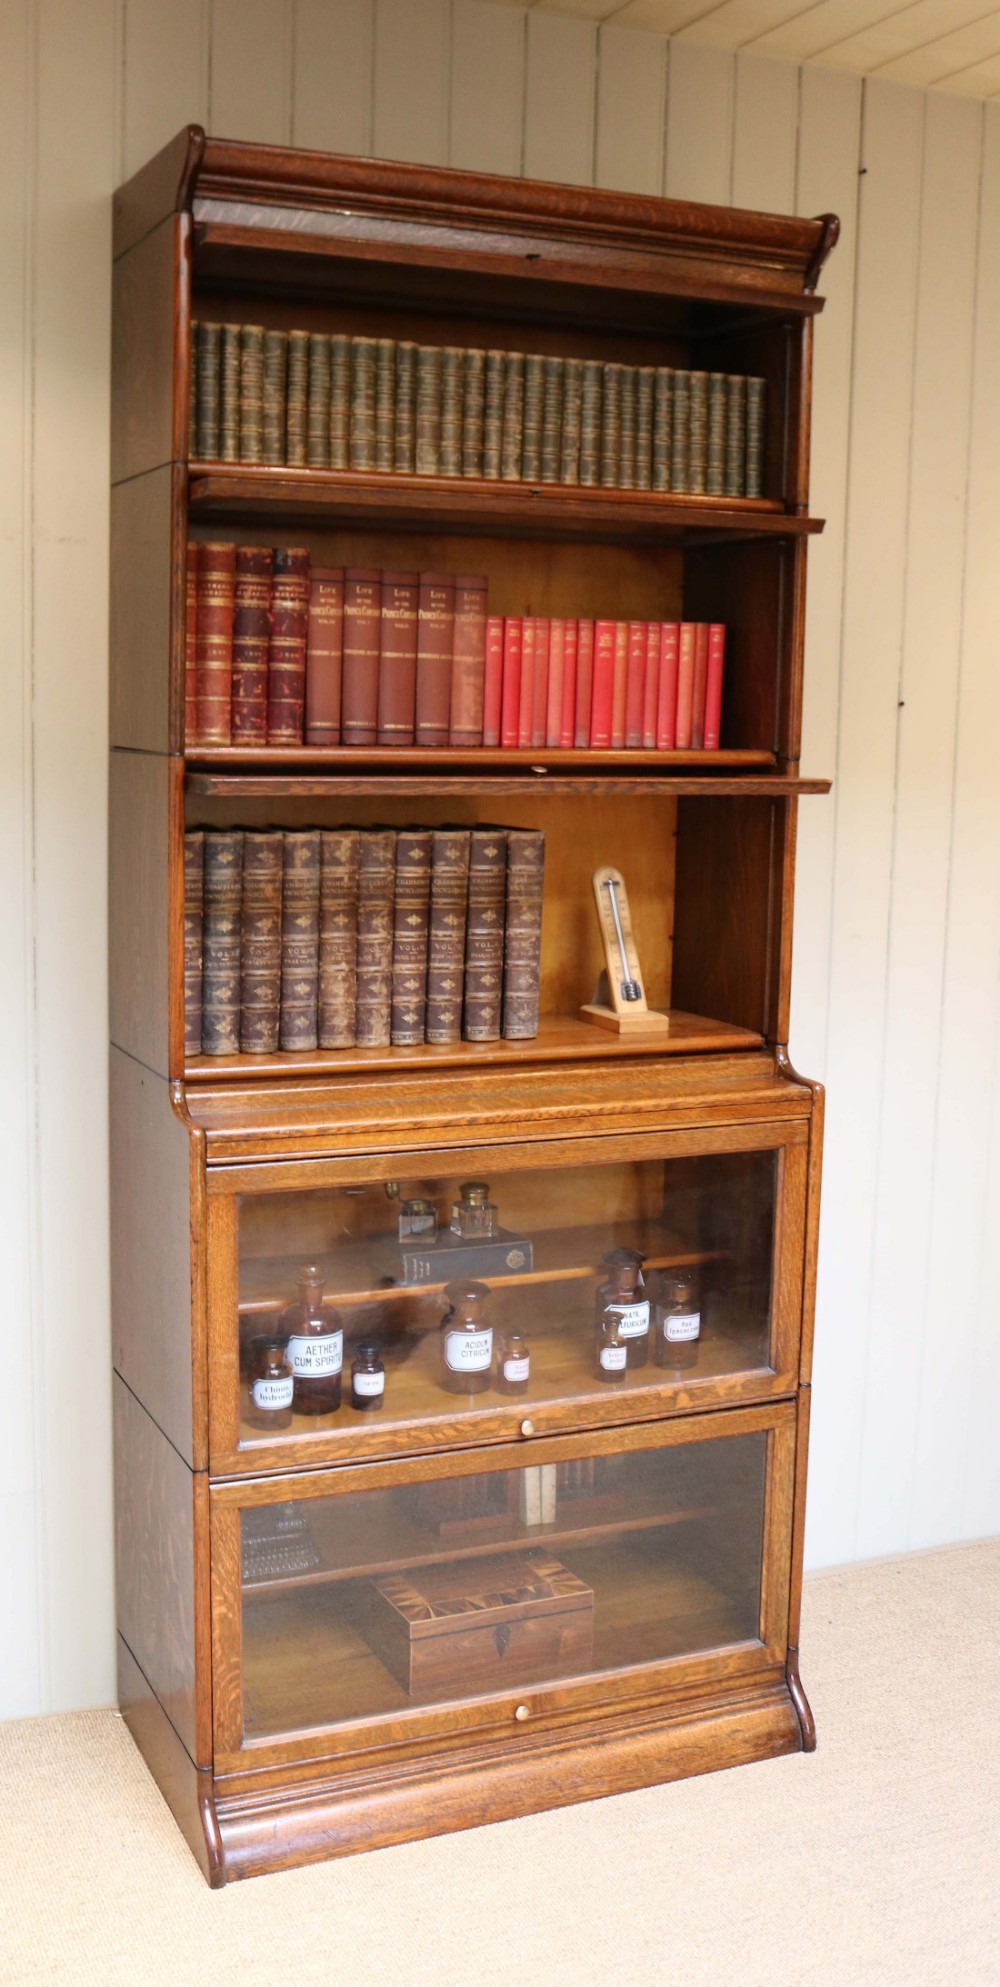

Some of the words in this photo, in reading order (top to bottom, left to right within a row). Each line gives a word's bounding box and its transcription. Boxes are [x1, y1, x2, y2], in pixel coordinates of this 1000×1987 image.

[306, 1342, 338, 1356] AETHER
[465, 1339, 488, 1349] ACIDUM
[461, 1348, 490, 1358] CITRICUM
[294, 1357, 312, 1368] CUM
